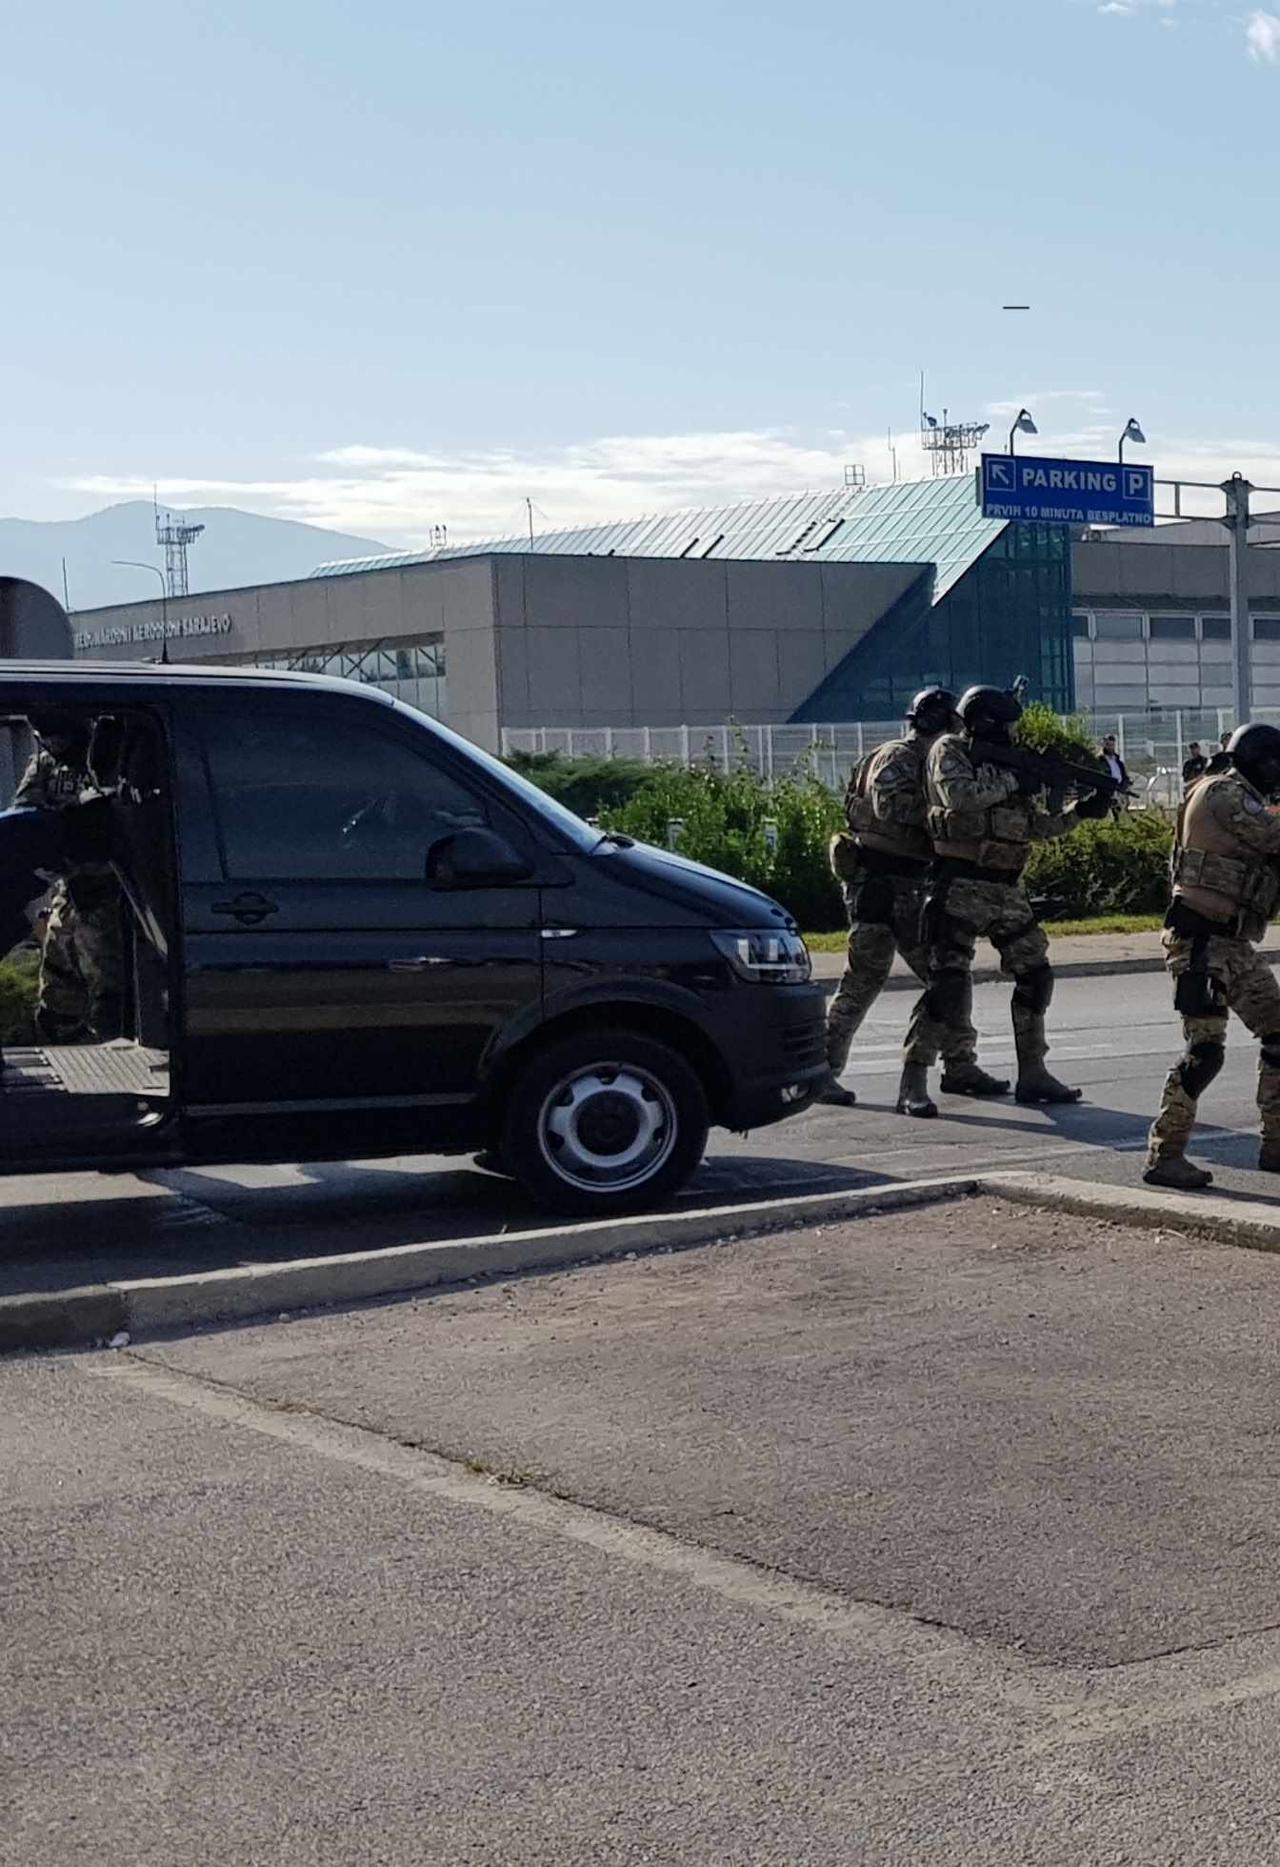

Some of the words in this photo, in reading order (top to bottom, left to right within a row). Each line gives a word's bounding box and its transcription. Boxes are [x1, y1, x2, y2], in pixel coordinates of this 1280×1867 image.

[1022, 468, 1117, 492] PARKING
[1129, 473, 1144, 495] P
[986, 503, 1022, 516] PRVIH
[1025, 505, 1039, 518] 10
[1040, 506, 1084, 520] MINUTA
[1087, 509, 1151, 524] BESPLATNO
[182, 613, 231, 636] SARAJEVO
